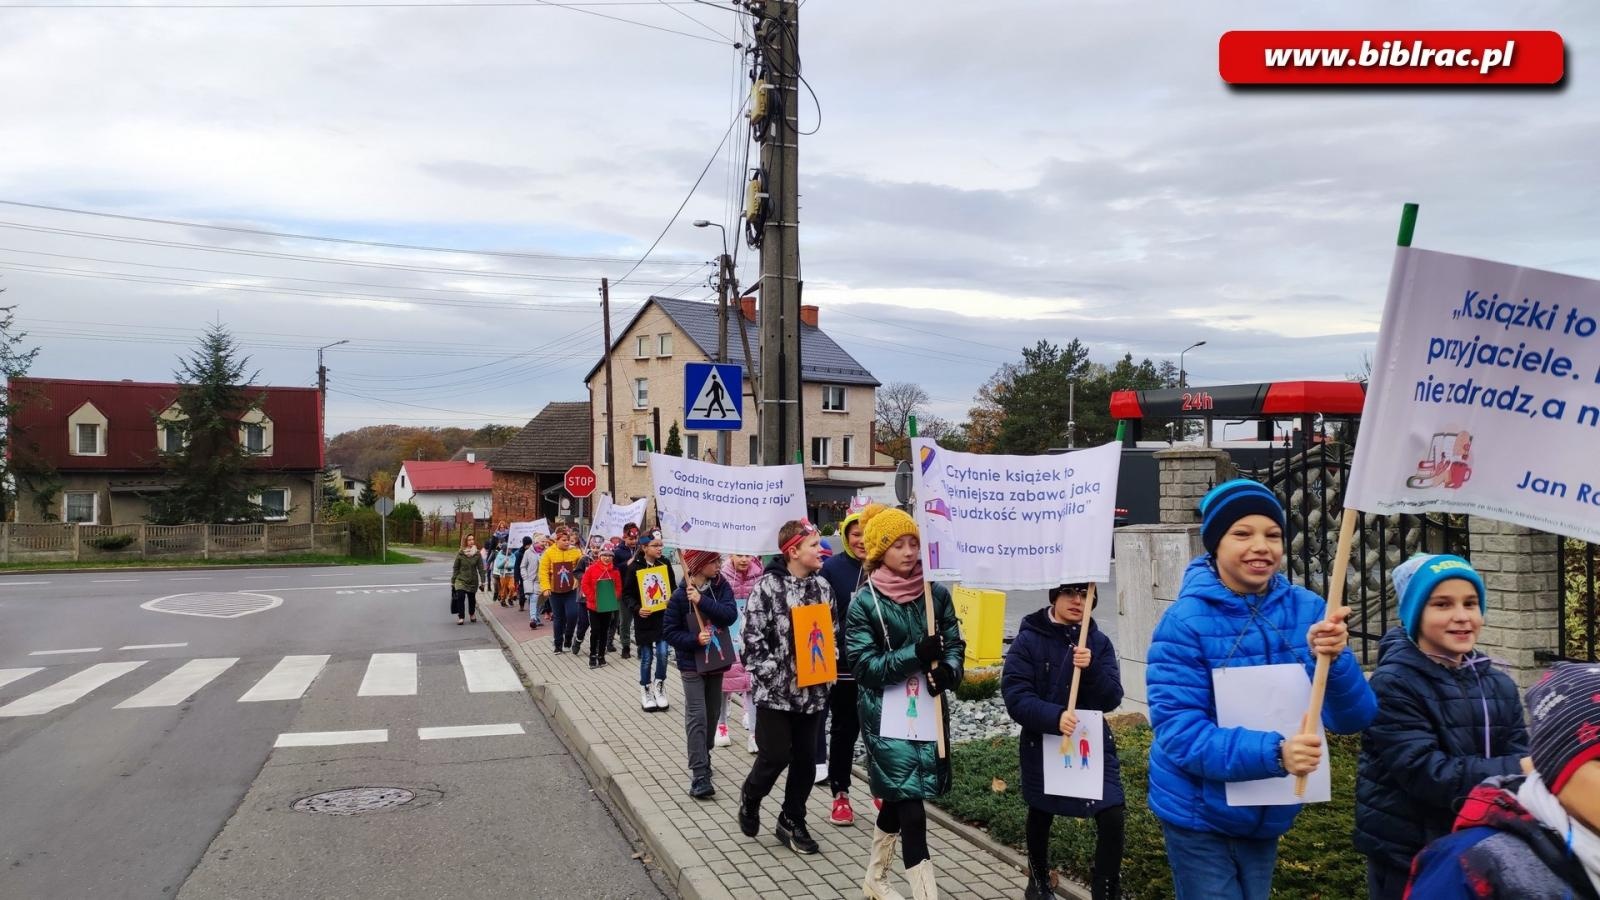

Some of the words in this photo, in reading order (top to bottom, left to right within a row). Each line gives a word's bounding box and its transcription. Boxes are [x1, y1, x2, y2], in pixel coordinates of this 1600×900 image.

[1563, 307, 1597, 338] to
[1427, 335, 1579, 380] przyjaciele.
[1183, 392, 1214, 411] 24h
[568, 476, 594, 487] STOP
[946, 464, 1000, 482] Czytanie
[1006, 469, 1060, 485] książek
[1064, 467, 1075, 479] to
[717, 480, 764, 491] czytania
[765, 479, 784, 492] jest
[1070, 481, 1100, 499] jaką
[1516, 471, 1567, 498] Jan
[659, 485, 700, 501] godziną
[702, 491, 760, 507] skradzioną
[762, 497, 767, 505] z
[690, 517, 720, 529] Thomas
[722, 521, 757, 532] Wharton
[998, 541, 1063, 558] Szymborsk
